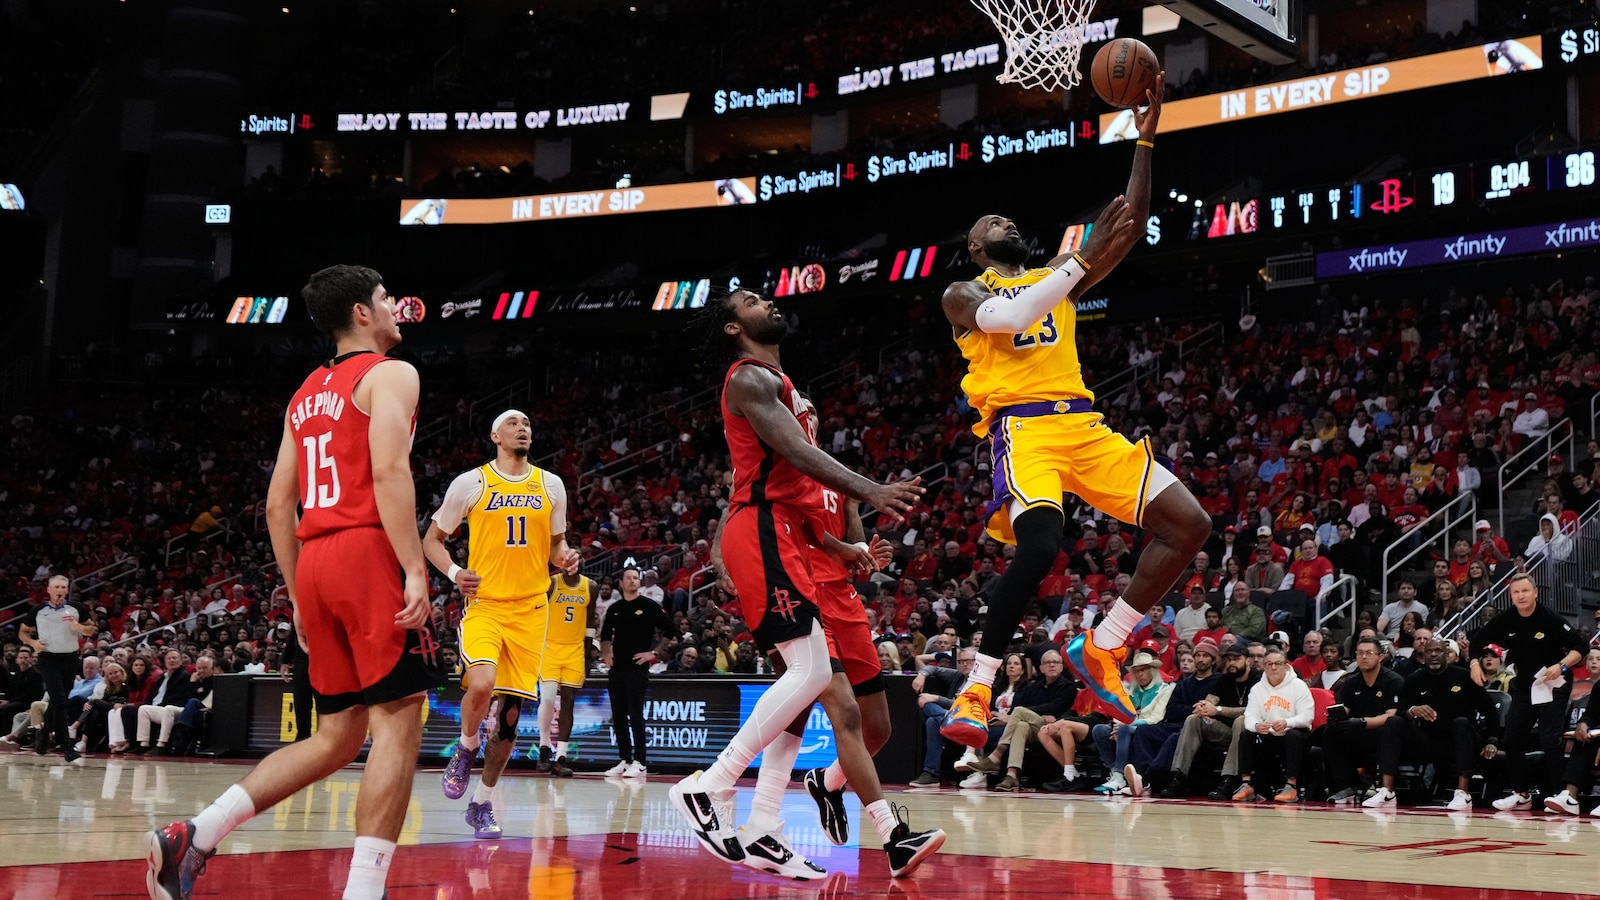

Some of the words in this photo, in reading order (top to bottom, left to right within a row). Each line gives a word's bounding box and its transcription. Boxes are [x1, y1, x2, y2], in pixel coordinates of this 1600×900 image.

[837, 66, 894, 95] ENJOY
[900, 57, 936, 82] THE
[941, 43, 999, 73] TASTE
[729, 91, 754, 110] Sire
[756, 87, 796, 109] Spirits
[1220, 94, 1247, 119] IN
[1254, 76, 1337, 113] EVERY
[1344, 67, 1390, 97] SIP
[249, 114, 288, 135] Spirits
[337, 113, 401, 131] ENJOY
[408, 112, 448, 131] THE
[455, 111, 518, 130] TASTE
[525, 110, 551, 129] OF
[557, 102, 630, 127] LUXURY
[998, 135, 1023, 156] Sire
[1026, 128, 1068, 154] Spirits
[882, 156, 906, 178] Sire
[908, 150, 947, 175] Spirits
[1490, 161, 1531, 191] 8:04
[1565, 151, 1595, 188] 36
[774, 176, 797, 195] Sire
[799, 170, 835, 193] Spirits
[1431, 172, 1455, 206] 19
[512, 199, 533, 220] IN
[539, 192, 604, 218] EVERY
[608, 189, 645, 212] SIP
[1273, 209, 1283, 228] 5
[1303, 205, 1310, 224] 1
[1331, 201, 1338, 220] 1
[1444, 234, 1506, 260] xfinity
[1545, 221, 1600, 248] xfinit
[1349, 247, 1407, 273] xfinity
[291, 390, 345, 431] SHEPPARD
[302, 430, 341, 509] 15
[484, 491, 543, 511] LAKERS
[505, 515, 528, 547] 11
[555, 592, 586, 605] LAKERS
[564, 606, 575, 624] 5
[652, 700, 706, 721] MOVIE
[668, 726, 708, 749] NOW
